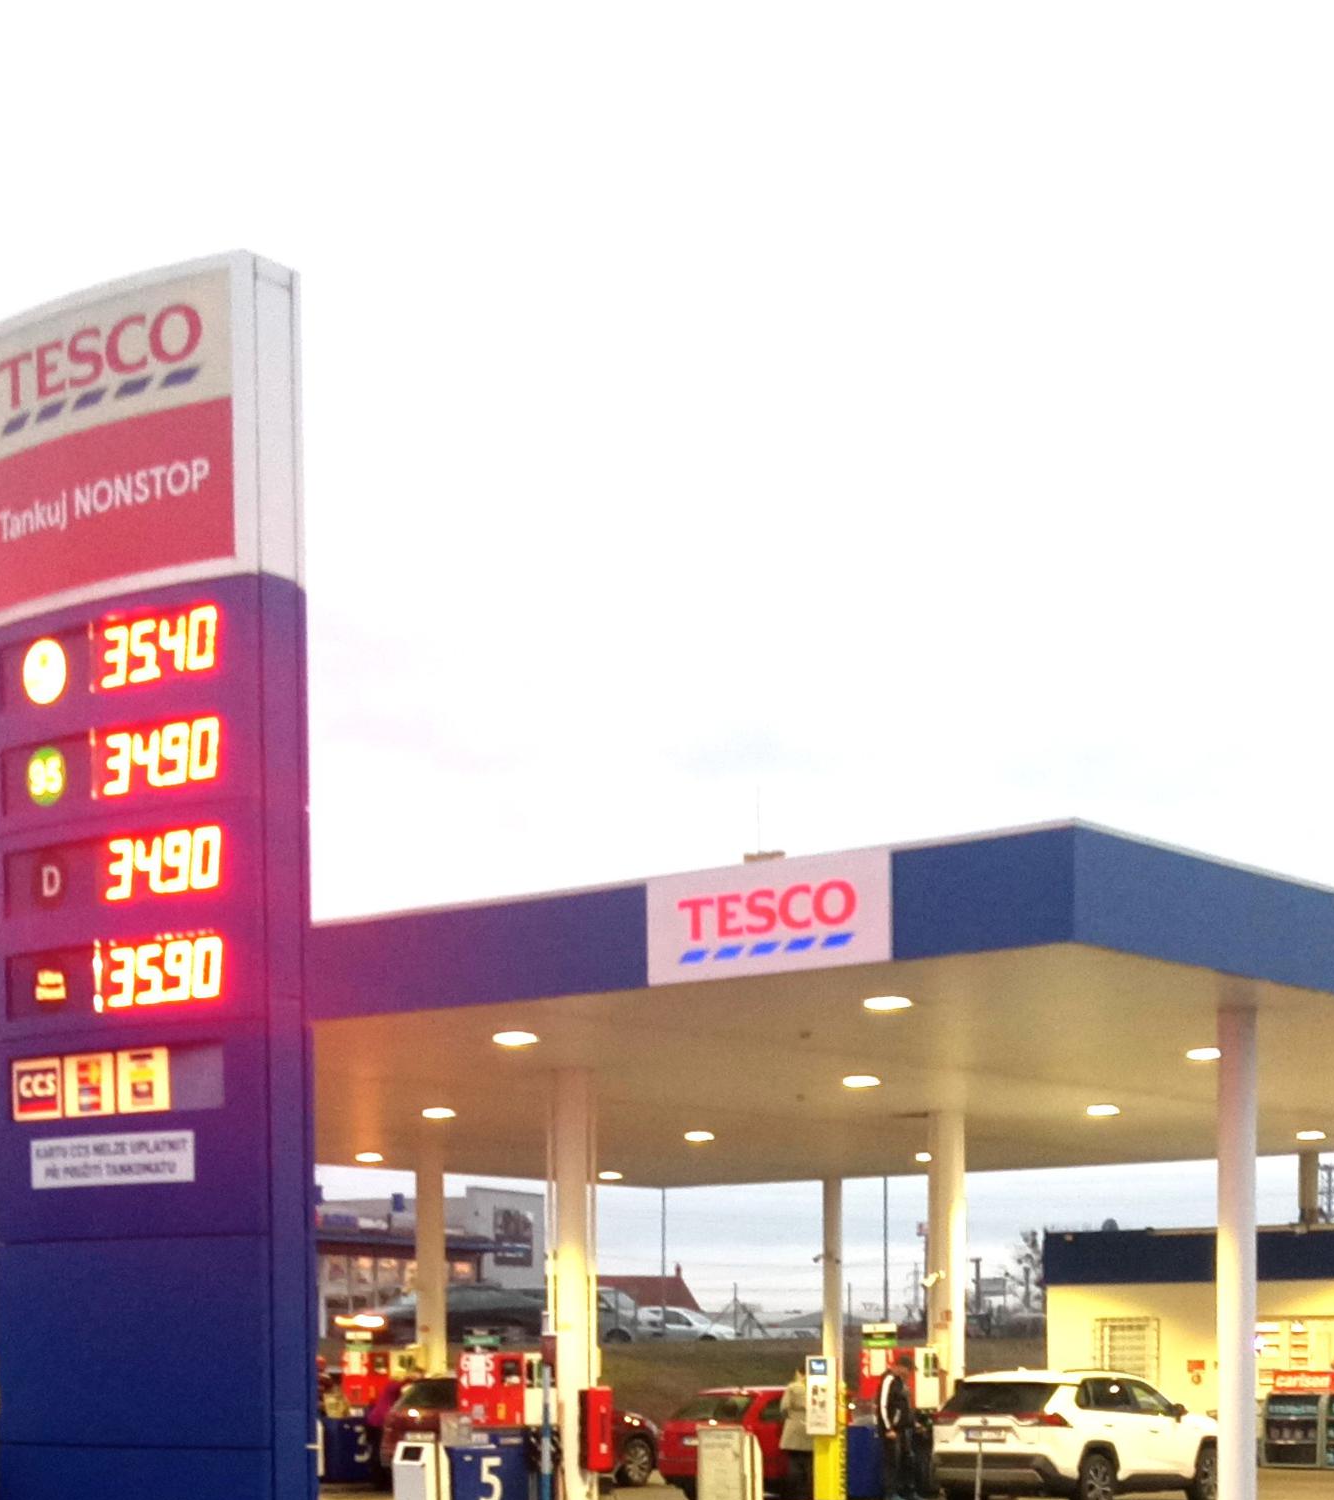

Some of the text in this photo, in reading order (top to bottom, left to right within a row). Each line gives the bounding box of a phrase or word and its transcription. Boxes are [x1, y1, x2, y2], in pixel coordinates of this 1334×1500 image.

[74, 458, 210, 520] NONSTOP
[42, 865, 61, 897] D
[678, 880, 857, 941] TESCO
[19, 1074, 56, 1097] CCS
